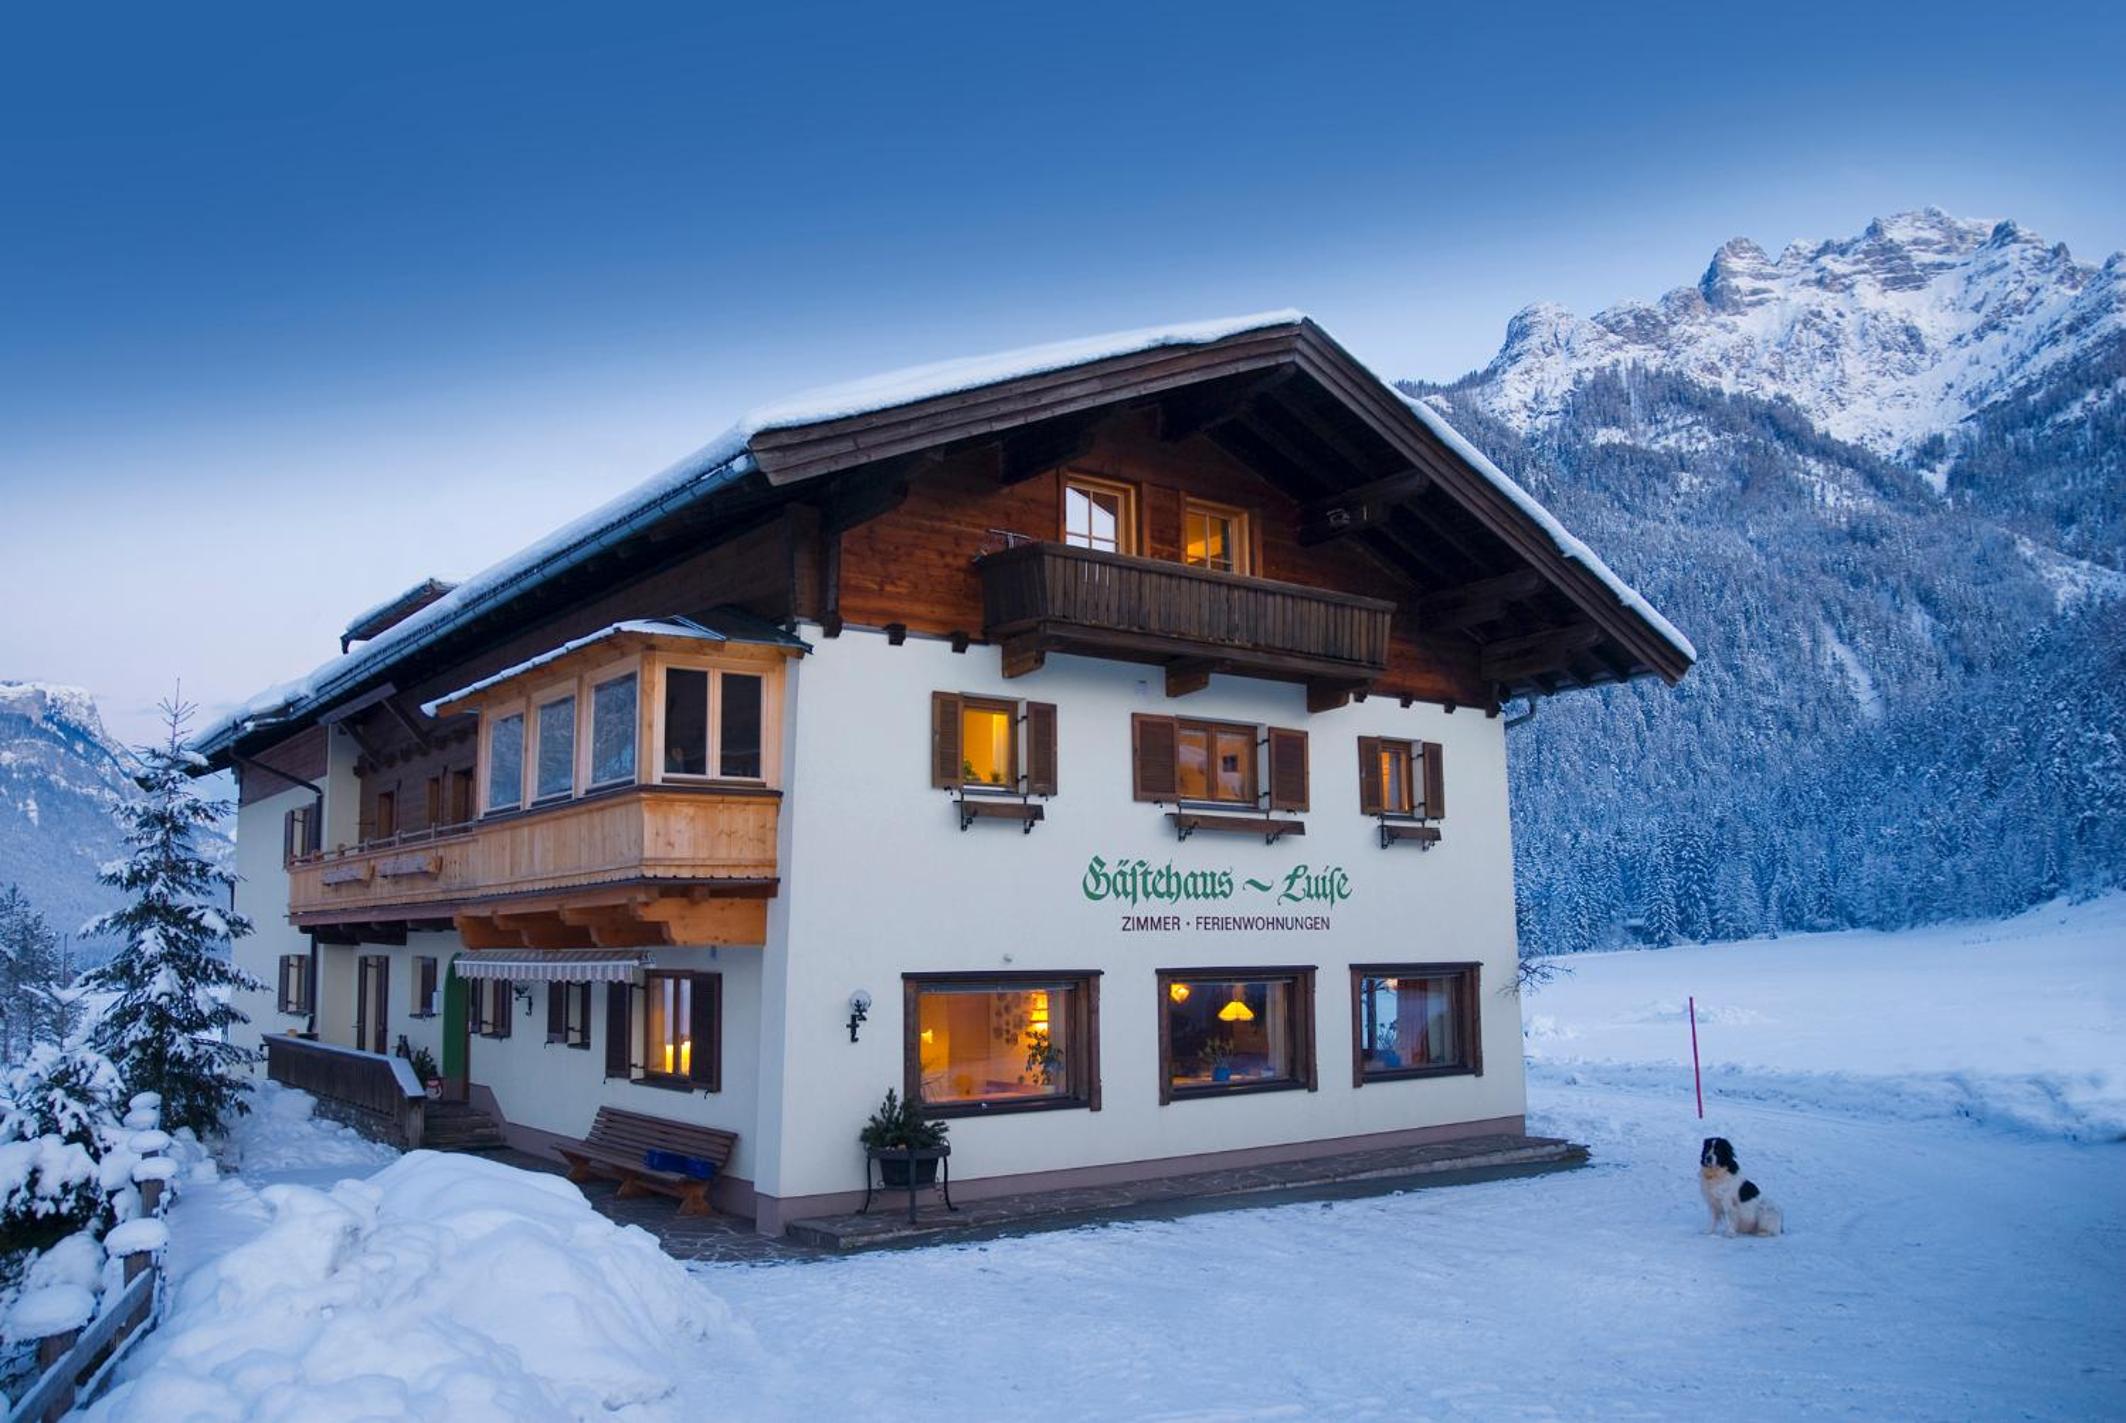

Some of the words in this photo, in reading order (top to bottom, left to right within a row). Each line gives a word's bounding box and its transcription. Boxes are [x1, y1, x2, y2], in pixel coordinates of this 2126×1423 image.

[1082, 855, 1234, 909] Gästehaus
[1277, 864, 1353, 910] Luise
[1121, 916, 1181, 932] ZIMMER
[1195, 915, 1330, 931] FERIENWOHNUNGEN
